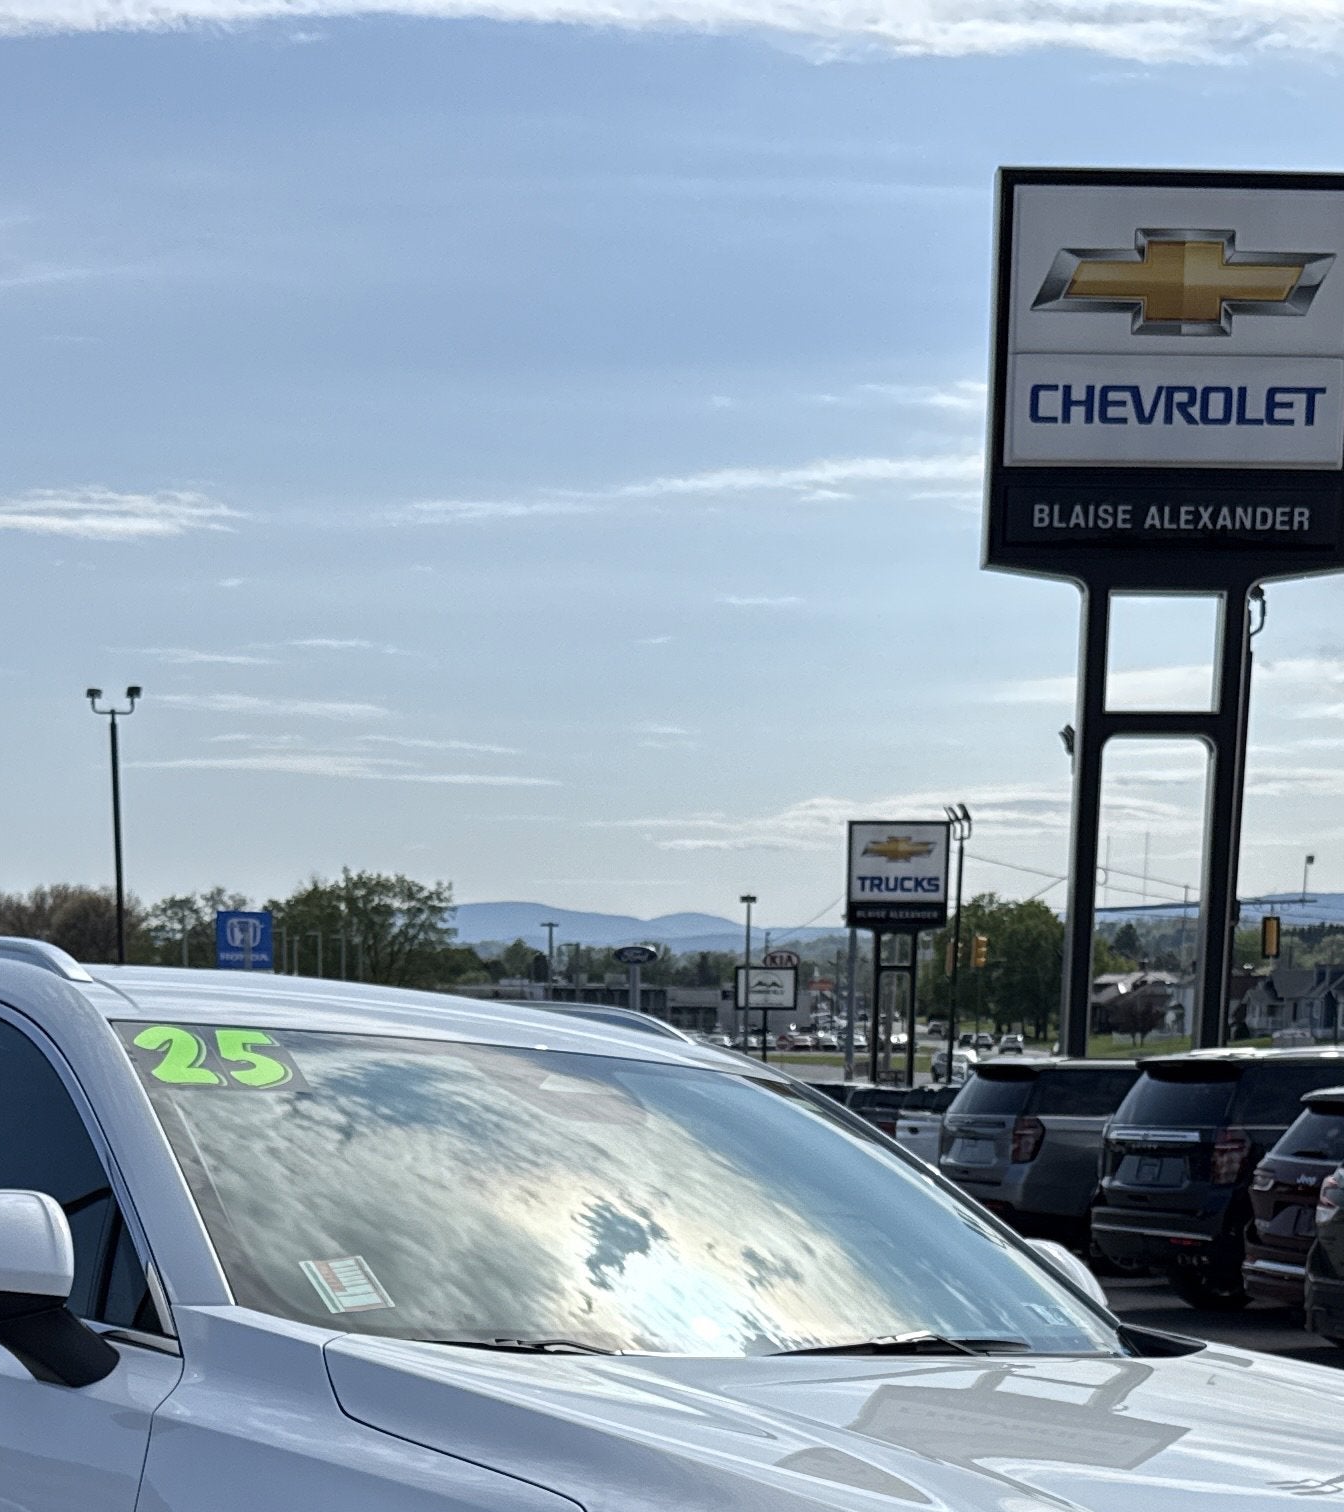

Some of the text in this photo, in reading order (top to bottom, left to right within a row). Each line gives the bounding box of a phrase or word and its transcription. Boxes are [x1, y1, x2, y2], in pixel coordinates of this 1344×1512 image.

[1029, 384, 1326, 427] CHEVROLET
[1033, 504, 1310, 532] BLAISE ALEXANDER
[857, 876, 940, 893] TRUCKS
[220, 952, 269, 961] HODA
[769, 955, 795, 966] KIA
[133, 1025, 294, 1089] 25
